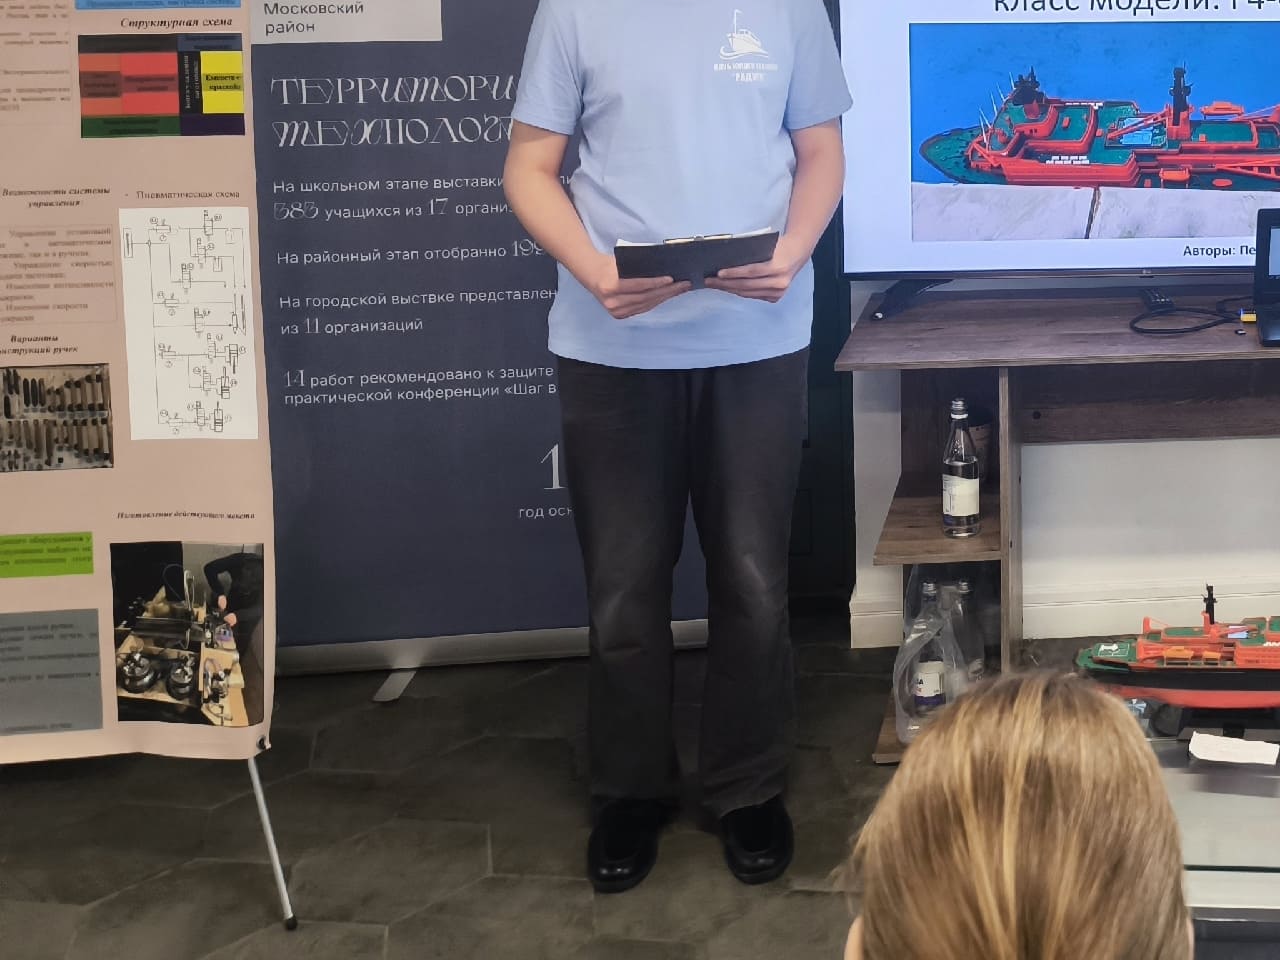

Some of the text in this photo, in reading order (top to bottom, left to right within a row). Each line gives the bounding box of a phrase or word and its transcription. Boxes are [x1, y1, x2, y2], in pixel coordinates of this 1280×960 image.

[264, 0, 364, 16] Московский
[266, 19, 316, 37] район
[274, 180, 296, 194] На
[301, 179, 380, 194] школьном
[385, 178, 429, 191] этапе
[325, 205, 400, 221] учащихся
[406, 206, 422, 217] из
[428, 198, 448, 215] 17
[277, 252, 299, 264] На
[304, 249, 381, 266] районный
[386, 250, 419, 262] этап
[424, 246, 507, 261] отобранно
[1183, 246, 1235, 258] Авторы:
[280, 296, 300, 308] На
[305, 292, 387, 310] городской
[391, 291, 455, 304] выствке
[281, 323, 299, 335] из
[325, 318, 424, 336] организаций
[310, 374, 354, 389] работ
[360, 369, 482, 386] рекомендовано
[487, 369, 495, 378] к
[500, 366, 554, 380] защите
[285, 383, 557, 406] практической конференции «Шаг в
[519, 507, 545, 519] год
